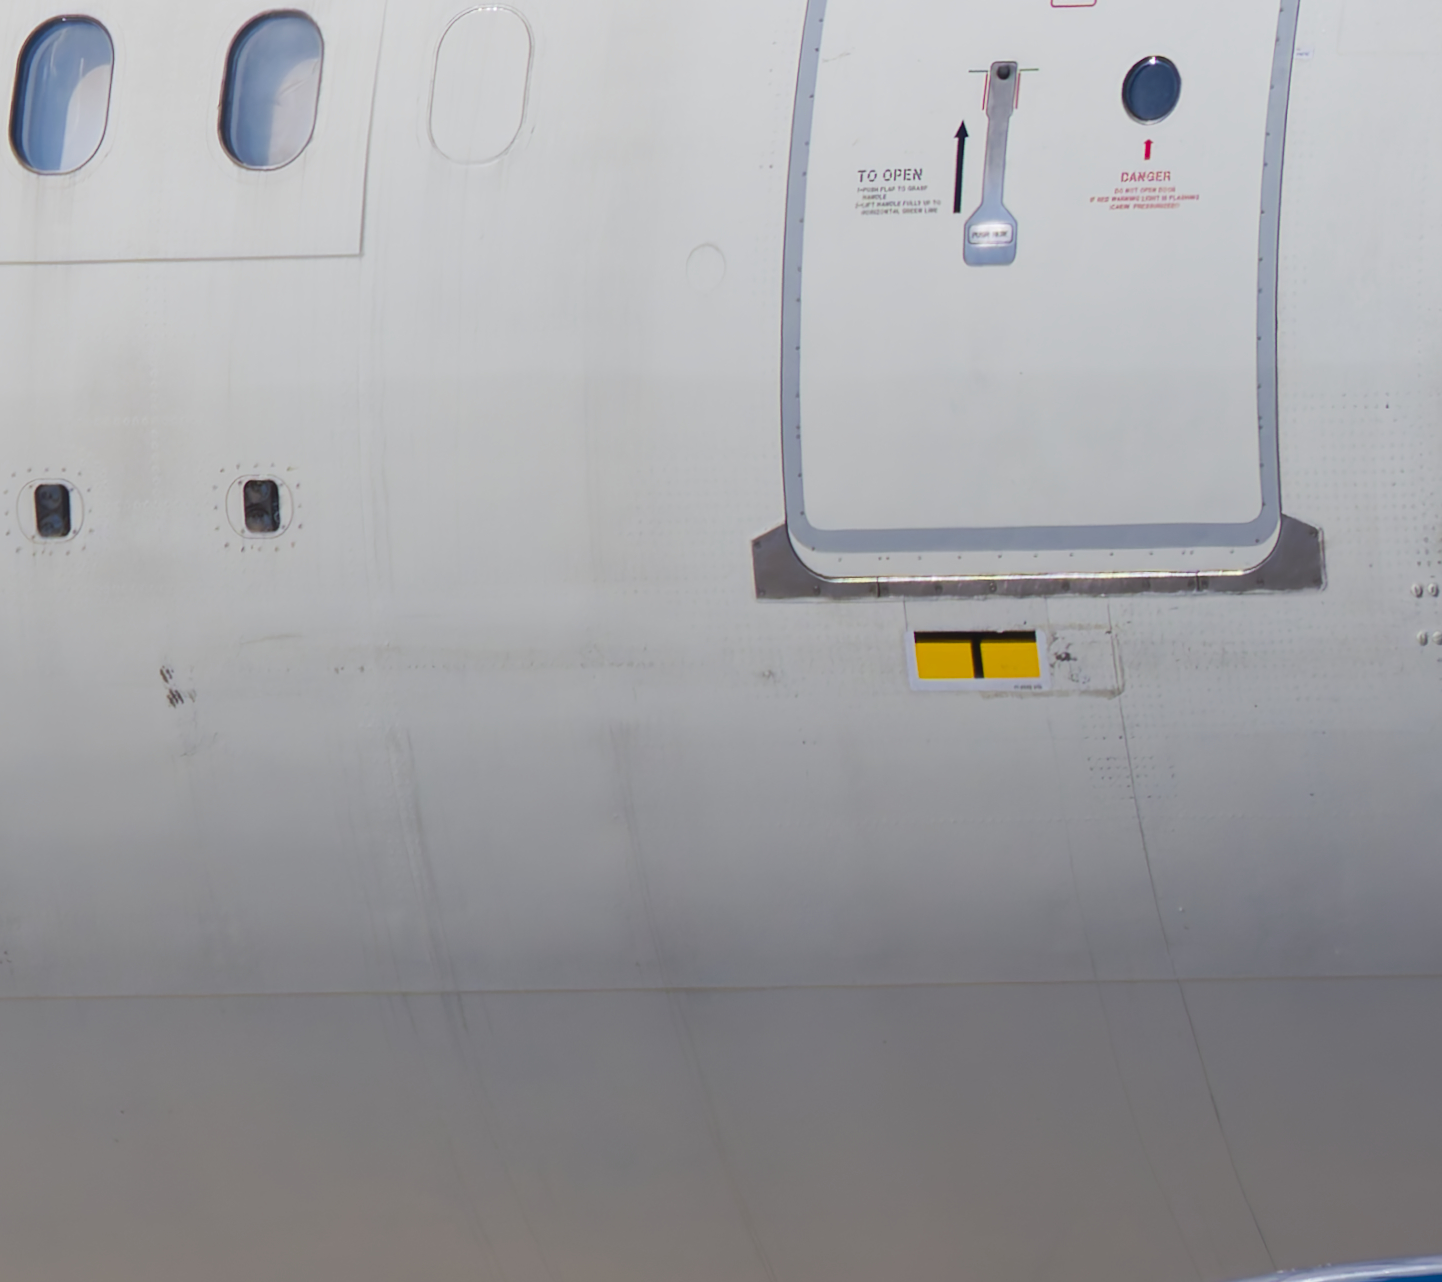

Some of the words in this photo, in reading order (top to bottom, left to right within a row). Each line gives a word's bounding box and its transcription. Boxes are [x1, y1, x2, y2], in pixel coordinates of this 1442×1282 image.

[858, 170, 877, 183] TO
[883, 168, 922, 181] OPEN
[1121, 171, 1171, 182] DANGER
